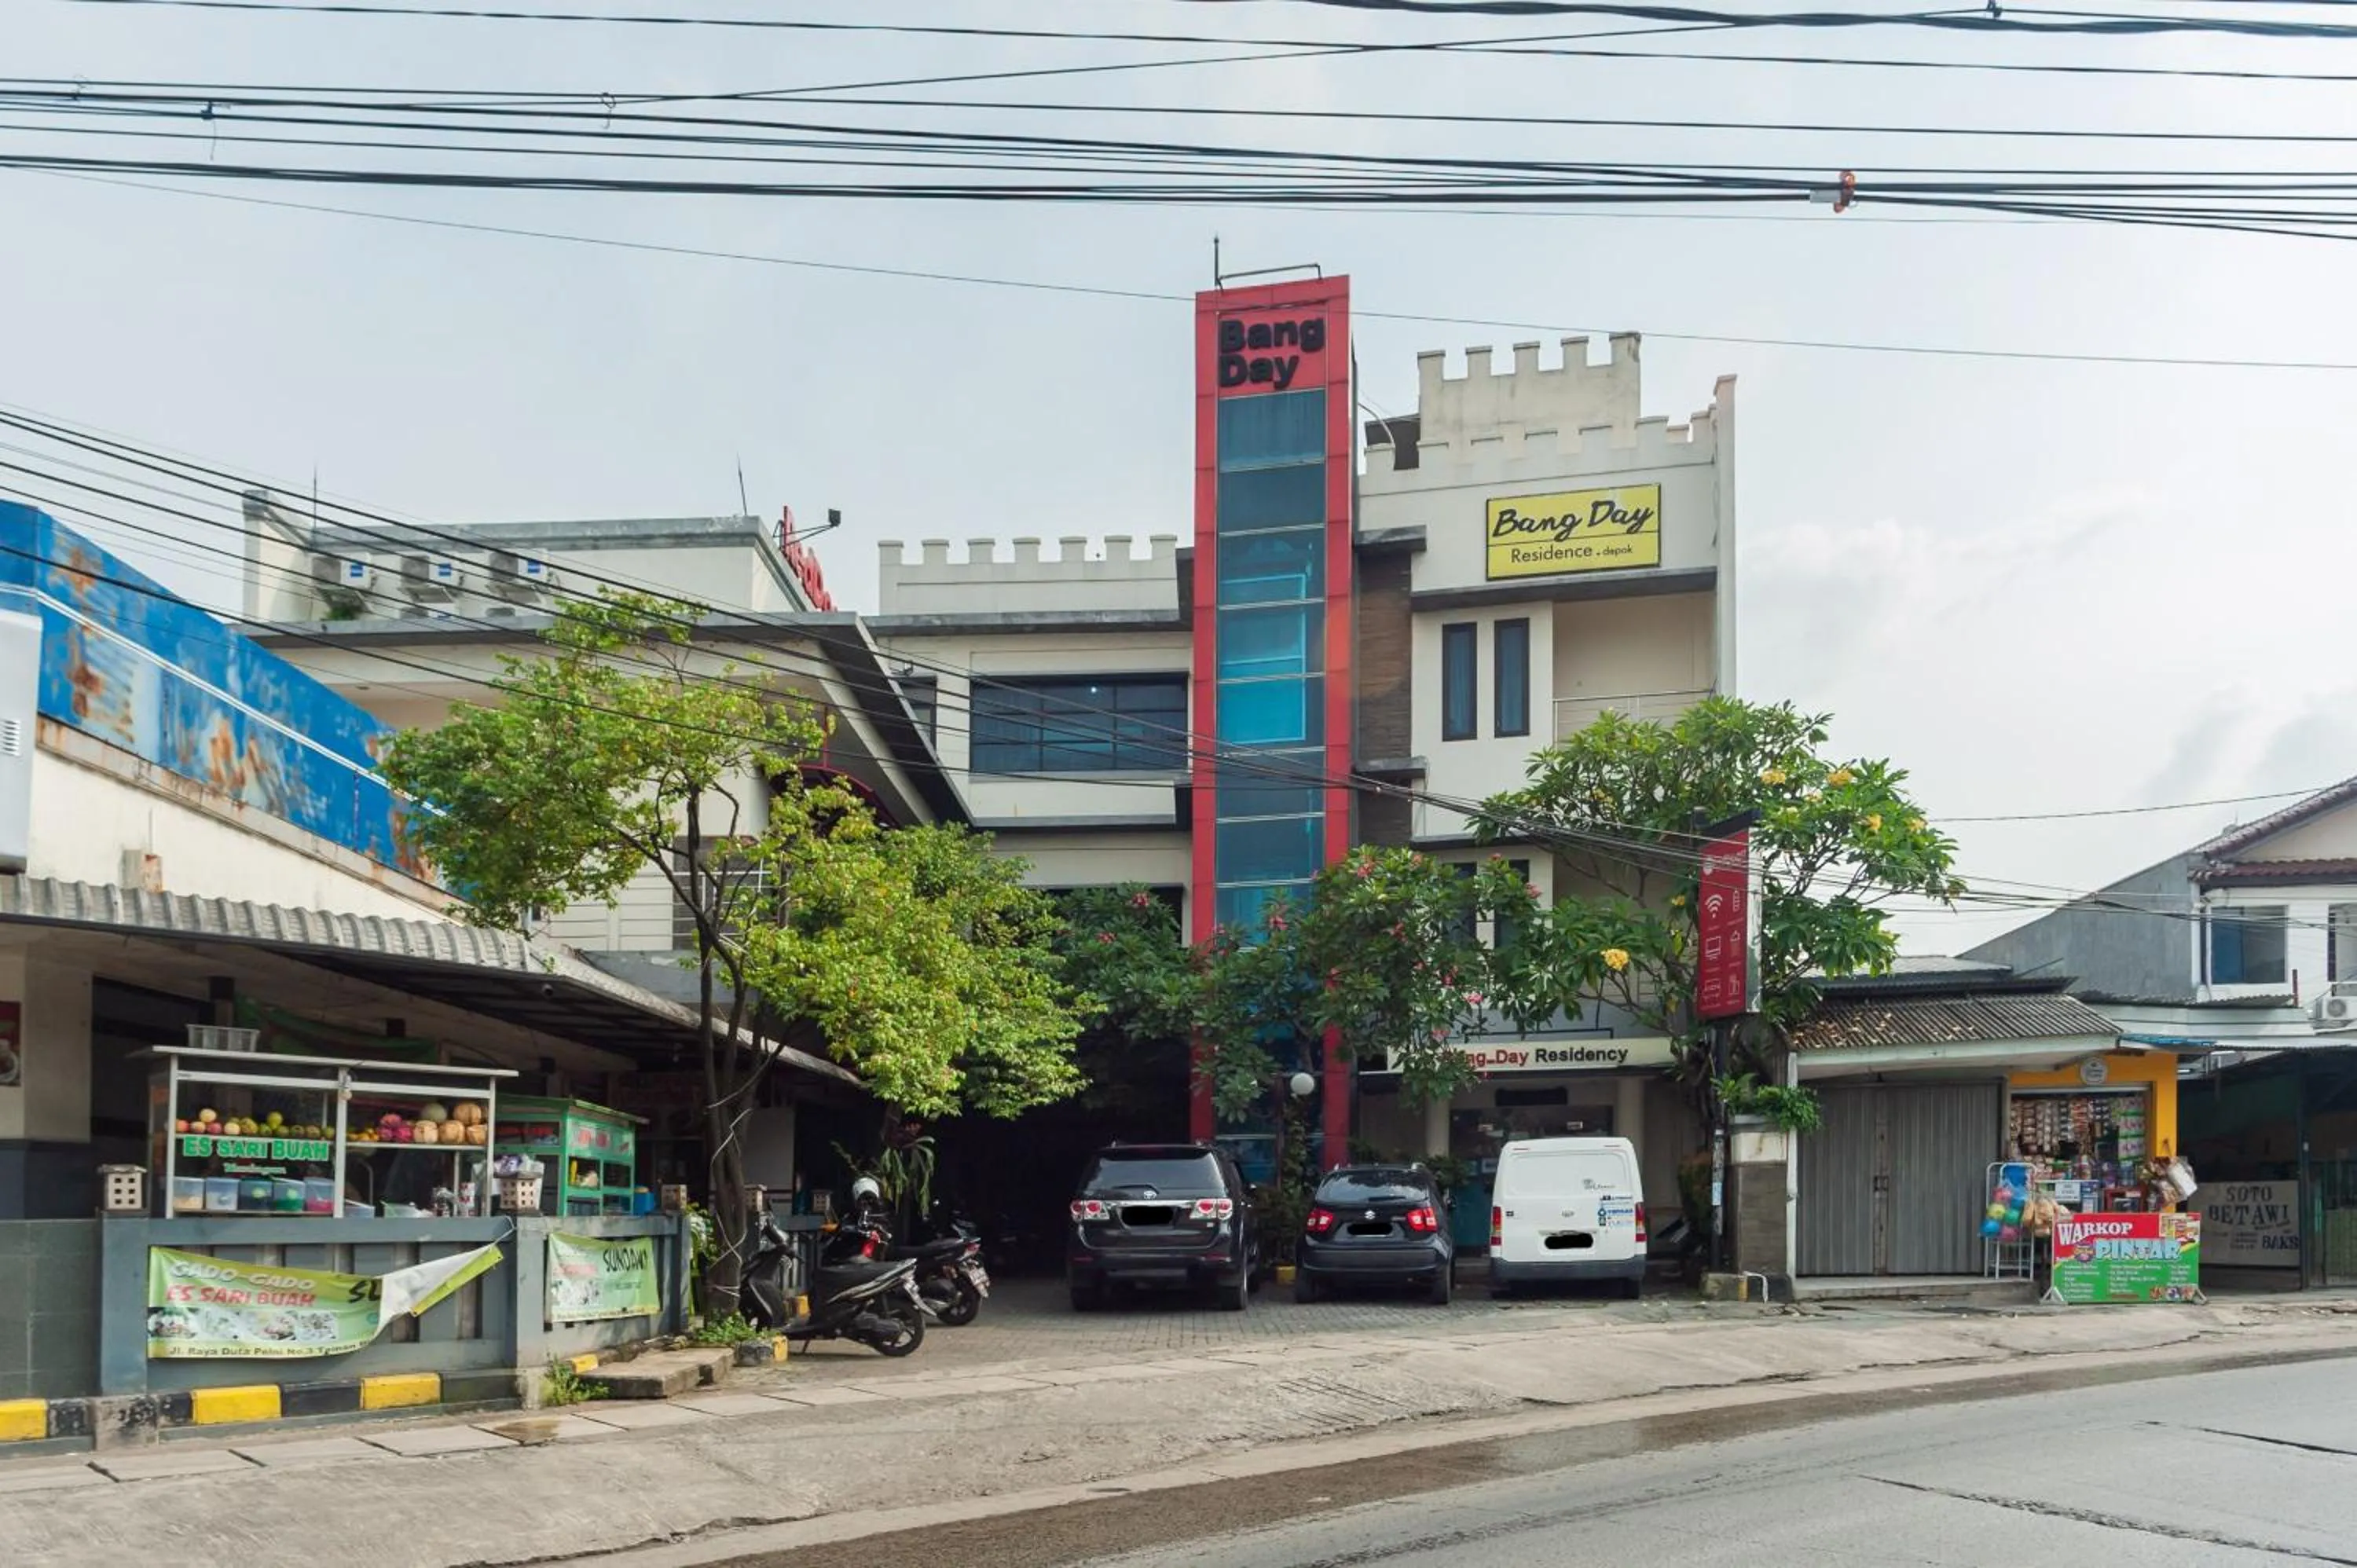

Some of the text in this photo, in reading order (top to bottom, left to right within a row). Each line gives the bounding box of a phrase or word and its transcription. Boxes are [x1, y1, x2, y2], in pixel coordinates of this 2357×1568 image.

[1220, 318, 1325, 353] Bang
[1219, 354, 1300, 390] Day
[1492, 500, 1655, 542] Bang Day
[1511, 544, 1593, 563] Residence
[1535, 1046, 1629, 1063] Residency
[182, 1136, 329, 1161] ES SARI BUAH
[2227, 1185, 2273, 1202] SOTO
[2209, 1204, 2289, 1226] BETAWI
[2057, 1222, 2133, 1246] WARKOP
[2095, 1238, 2181, 1261] PINTAR
[167, 1283, 317, 1307] ES SARI BUAH
[188, 1346, 218, 1357] Raya
